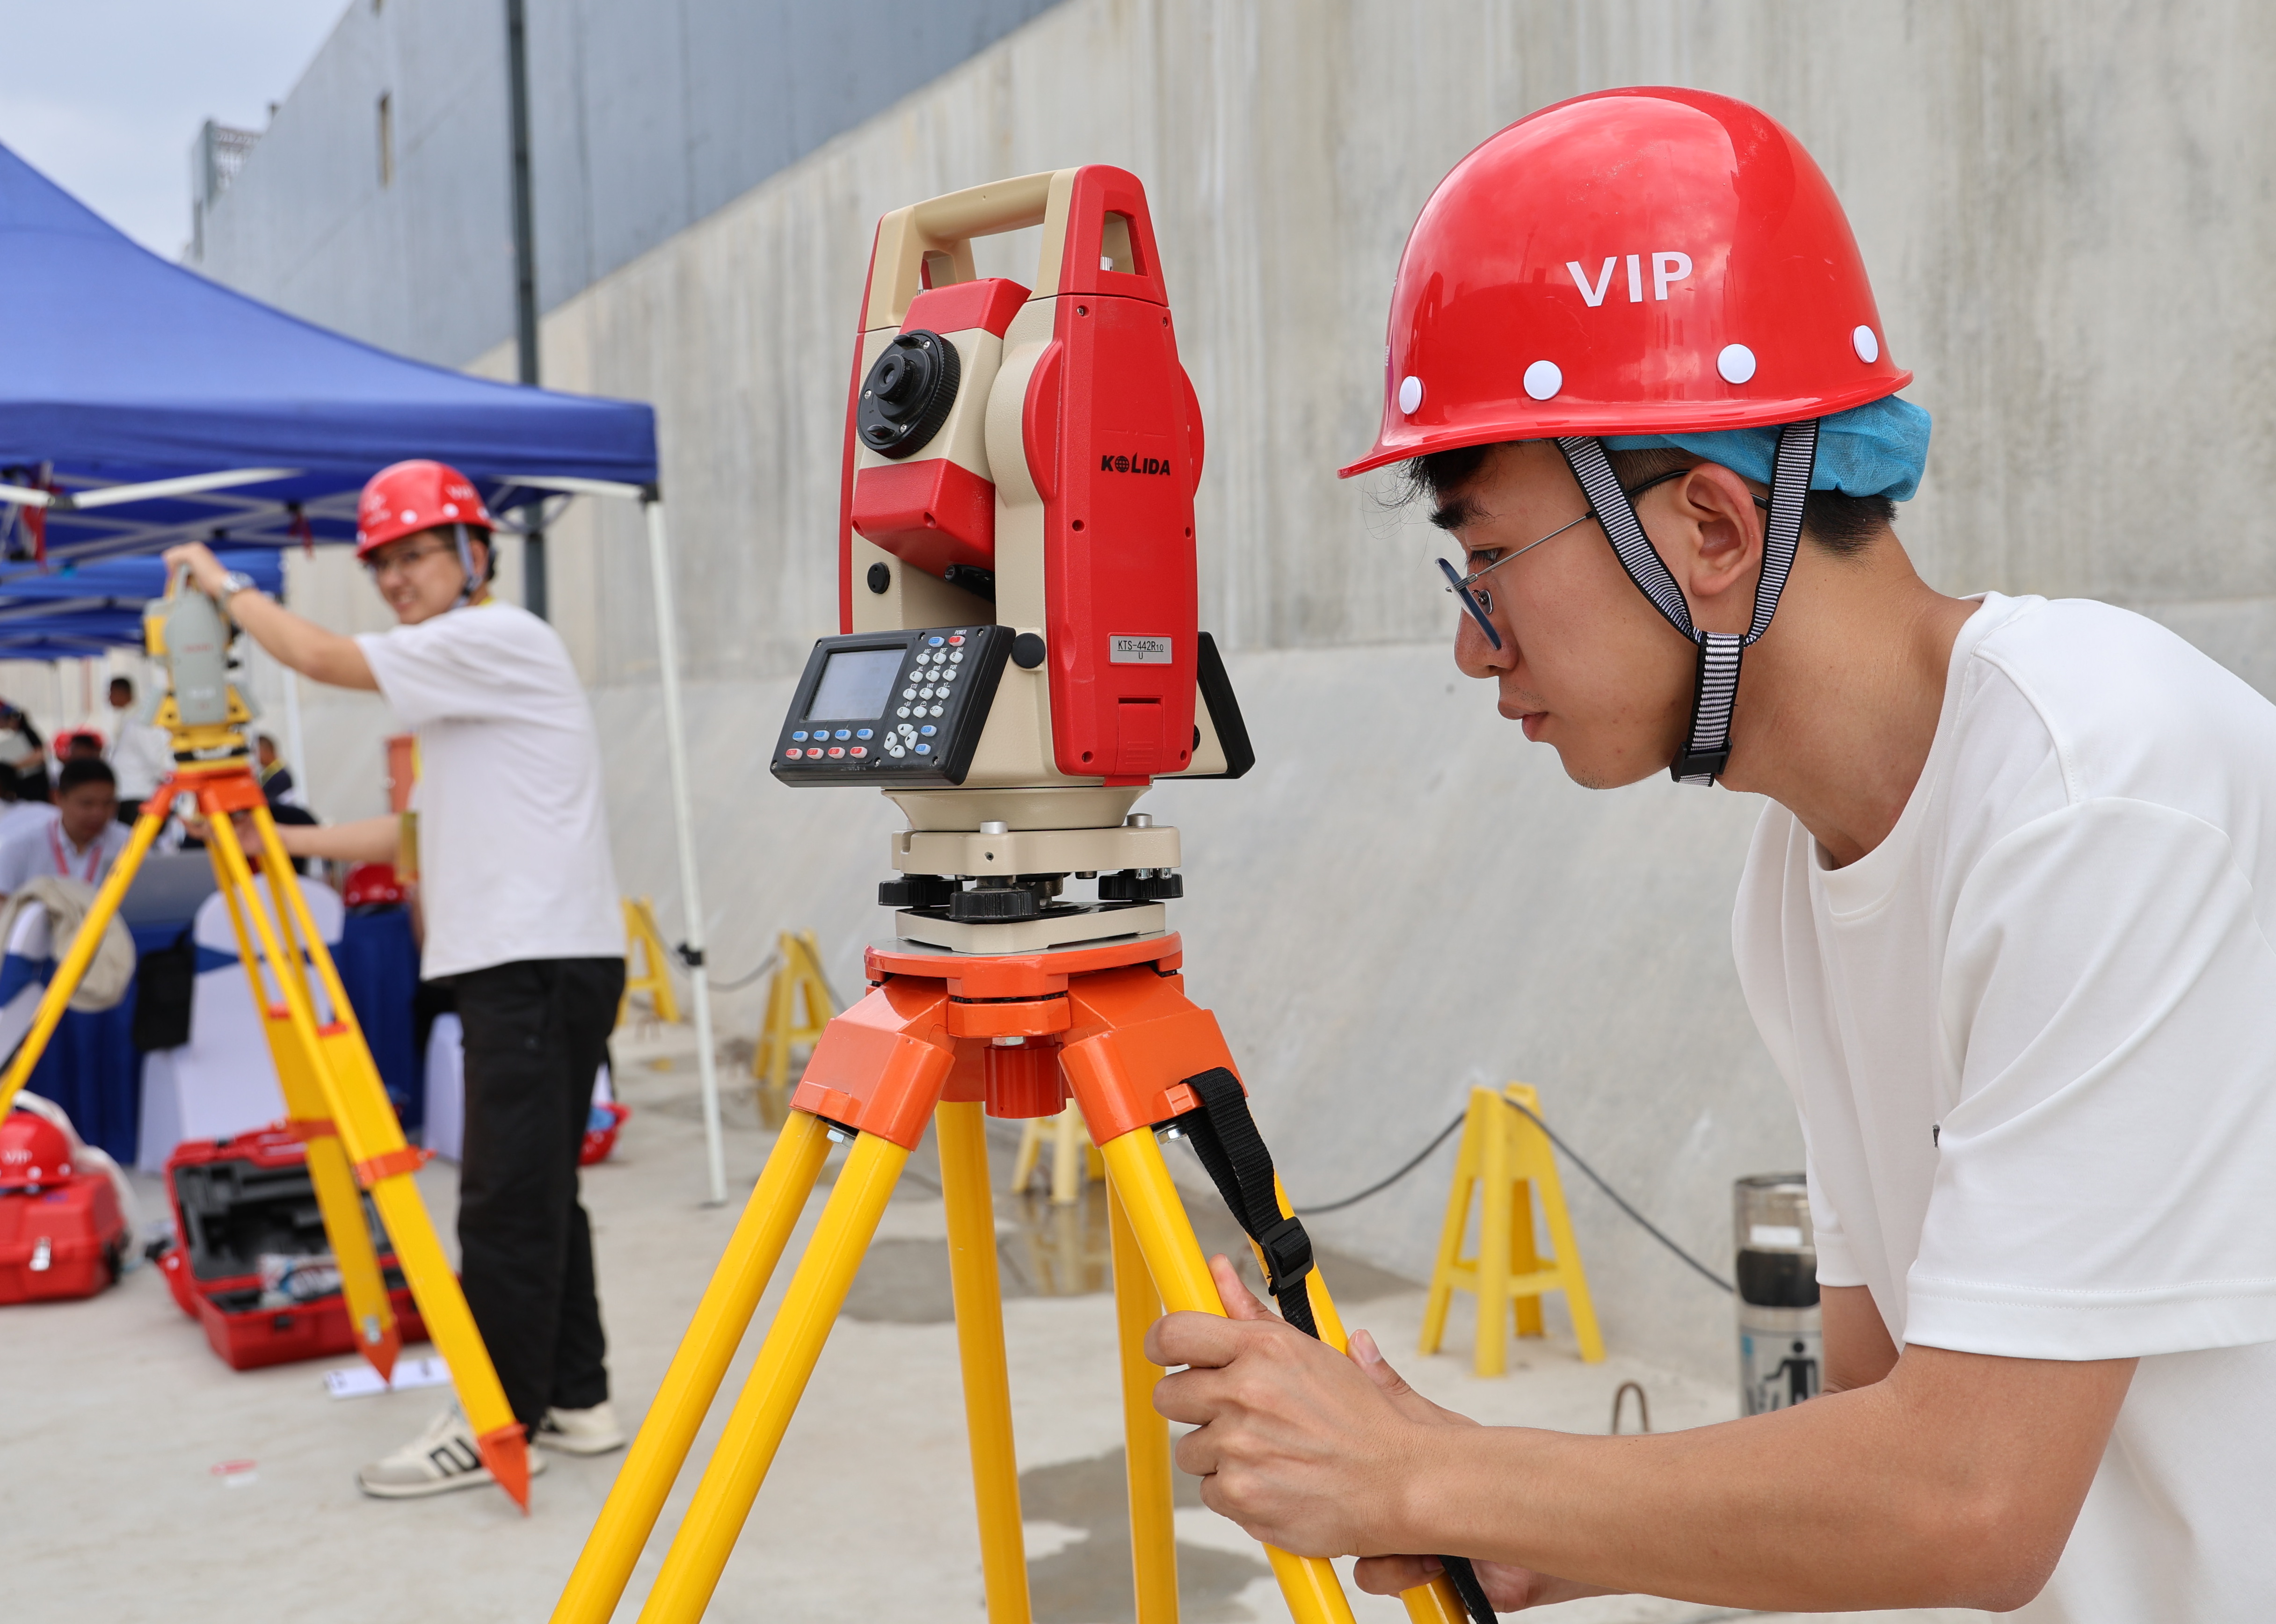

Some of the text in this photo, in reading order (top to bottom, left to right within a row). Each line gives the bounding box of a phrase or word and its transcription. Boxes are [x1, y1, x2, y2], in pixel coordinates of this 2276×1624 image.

[1565, 251, 1693, 307] VIP
[1101, 451, 1171, 476] KOLIDA
[1118, 640, 1164, 651] KTS-442R10
